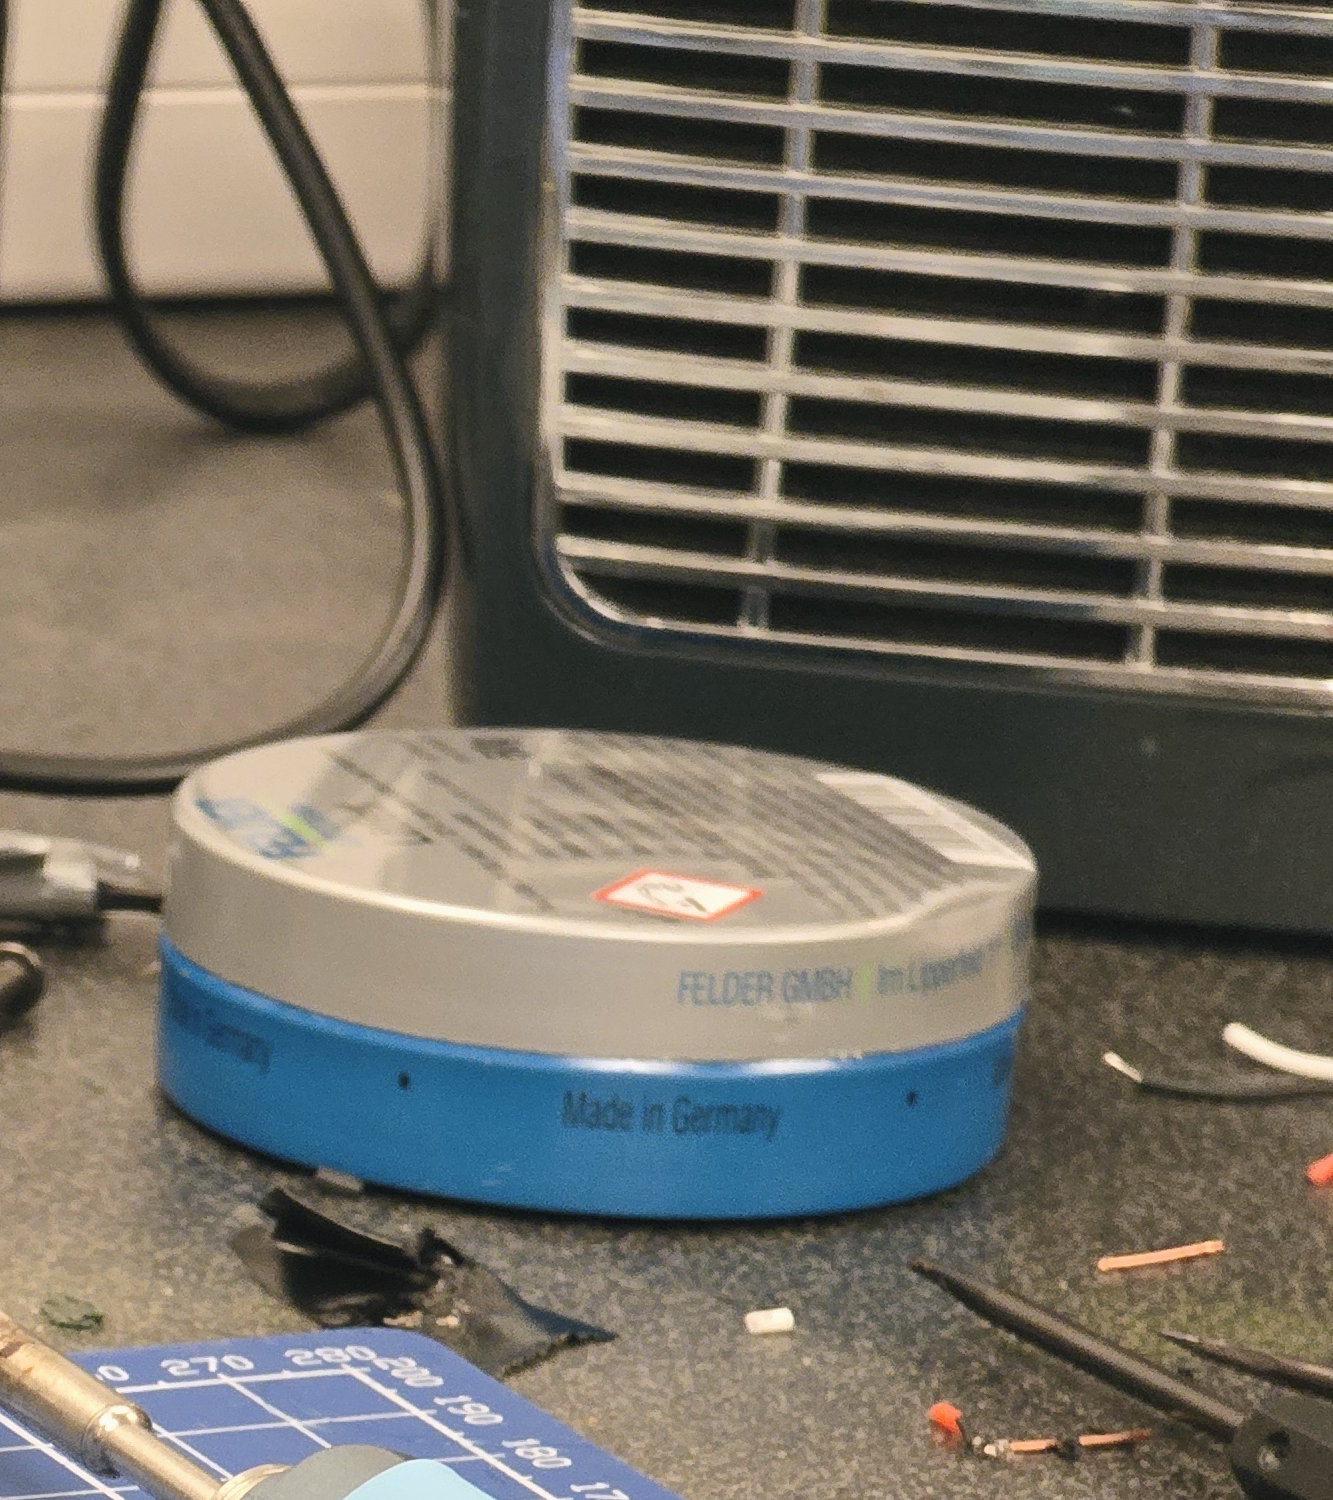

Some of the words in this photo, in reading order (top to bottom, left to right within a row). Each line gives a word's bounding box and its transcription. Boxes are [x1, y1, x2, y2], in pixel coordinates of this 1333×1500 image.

[678, 968, 774, 1006] FELDER
[561, 1088, 634, 1133] Made
[640, 1094, 665, 1134] in
[671, 1094, 781, 1142] Germany
[160, 1353, 255, 1377] 270
[284, 1343, 377, 1368] 280
[372, 1355, 445, 1388] 200
[433, 1394, 505, 1426] 190
[501, 1438, 573, 1470] 180
